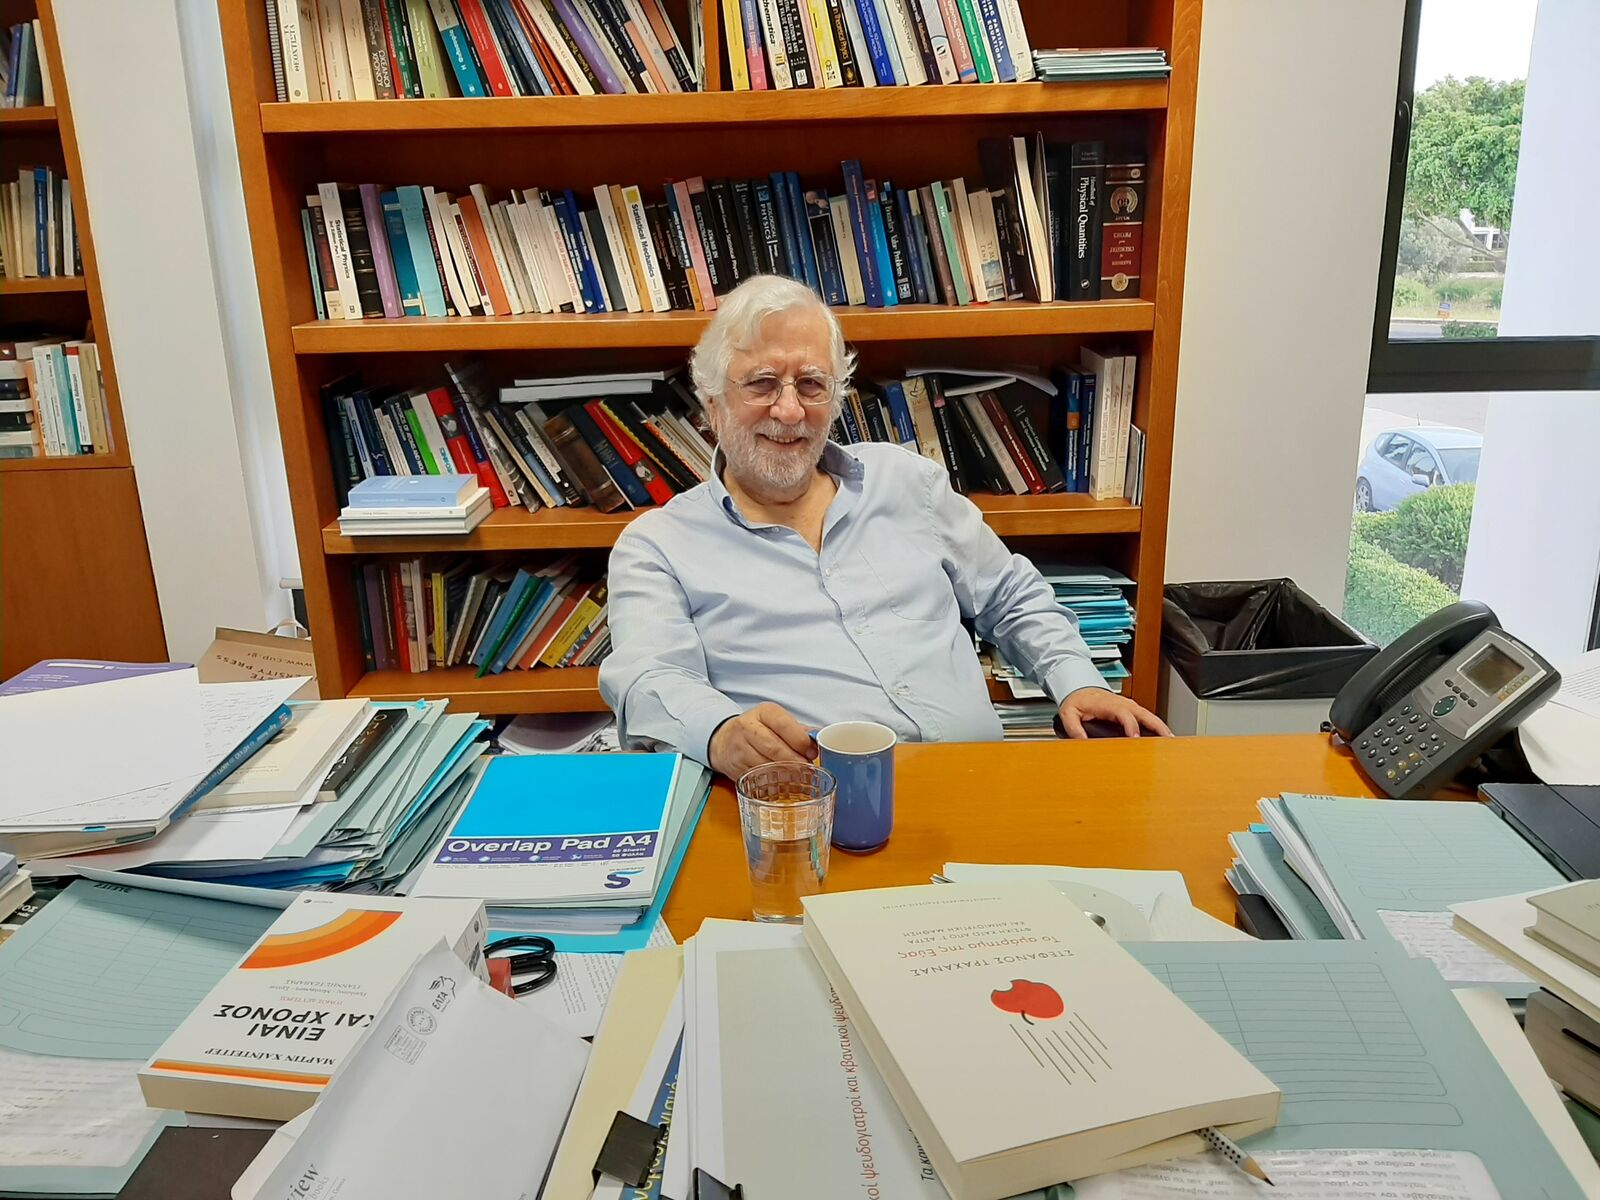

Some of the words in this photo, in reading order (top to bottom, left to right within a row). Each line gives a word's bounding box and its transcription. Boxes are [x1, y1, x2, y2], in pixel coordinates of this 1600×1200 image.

[986, 19, 1002, 63] EQUATIONS
[992, 18, 1005, 50] PARTIAL
[1076, 177, 1089, 212] Physical
[760, 202, 771, 240] PHYSICS
[631, 203, 646, 239] Statistical
[641, 240, 656, 277] Mechanics
[1077, 213, 1088, 259] Quantities
[334, 218, 346, 252] Statistical
[340, 253, 351, 279] Physics
[215, 654, 253, 670] PRESS
[447, 839, 552, 854] Overlap
[560, 837, 611, 851] Pad
[615, 834, 652, 847] A4
[938, 944, 965, 953] της
[967, 936, 1038, 950] αμάρτημα
[1041, 935, 1062, 943] Το
[897, 948, 937, 959] Εύας
[993, 949, 1075, 964] ΣΤΕΦΑΝΟΣ
[909, 959, 989, 977] ΤΡΑΧΑΝΑΣ
[432, 990, 449, 1010] ΕΛΤΑ
[213, 1004, 329, 1025] ΧΡΟΝΟΣ
[247, 1023, 326, 1042] ΕΙΝΑΙ
[840, 1023, 857, 1073] κβαντικοί
[285, 1054, 336, 1066] ΜΑΡΤΙΝ
[847, 1075, 860, 1093] και
[852, 1096, 880, 1180] ψευδογιατροί
